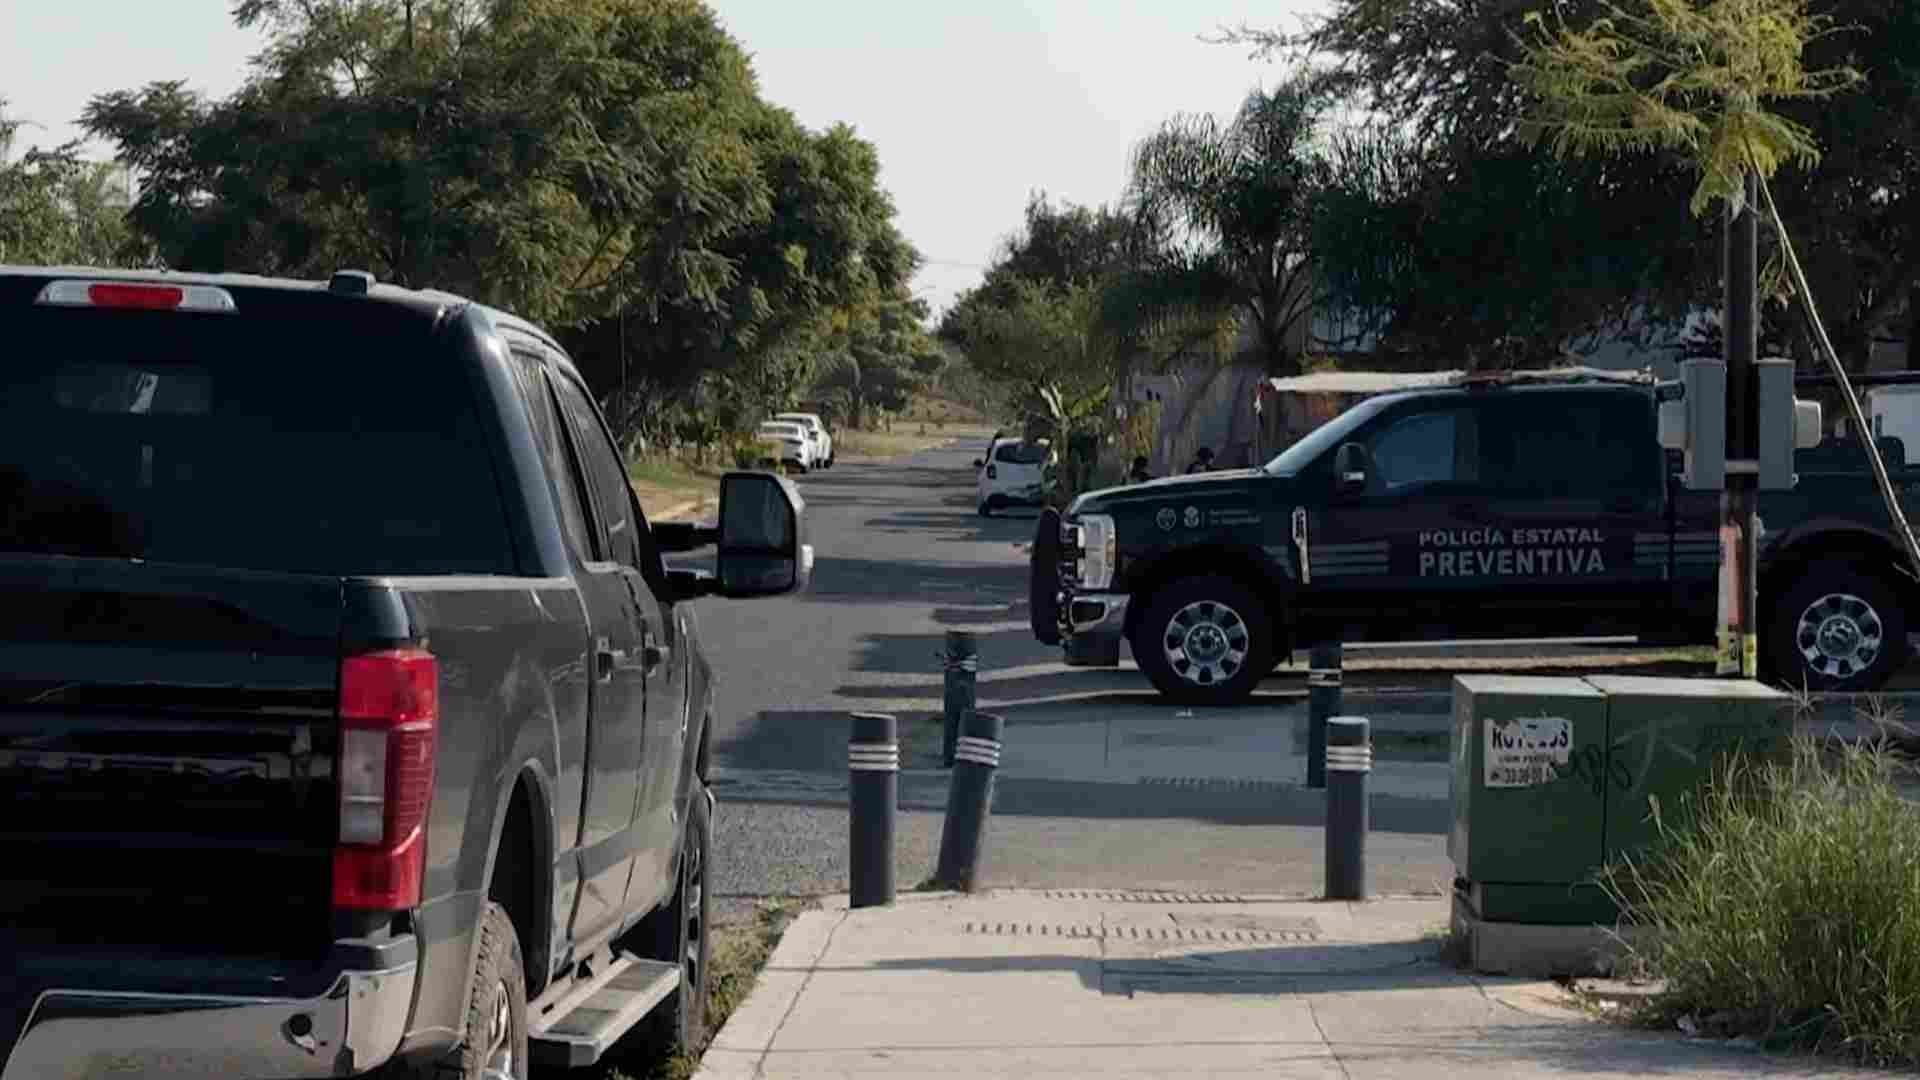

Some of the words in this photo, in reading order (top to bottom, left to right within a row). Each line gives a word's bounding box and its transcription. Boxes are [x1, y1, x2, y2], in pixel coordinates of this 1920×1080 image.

[1419, 525, 1505, 546] POLICÍA
[1512, 528, 1605, 544] ESTATAL
[1419, 547, 1606, 576] PREVENTIVA
